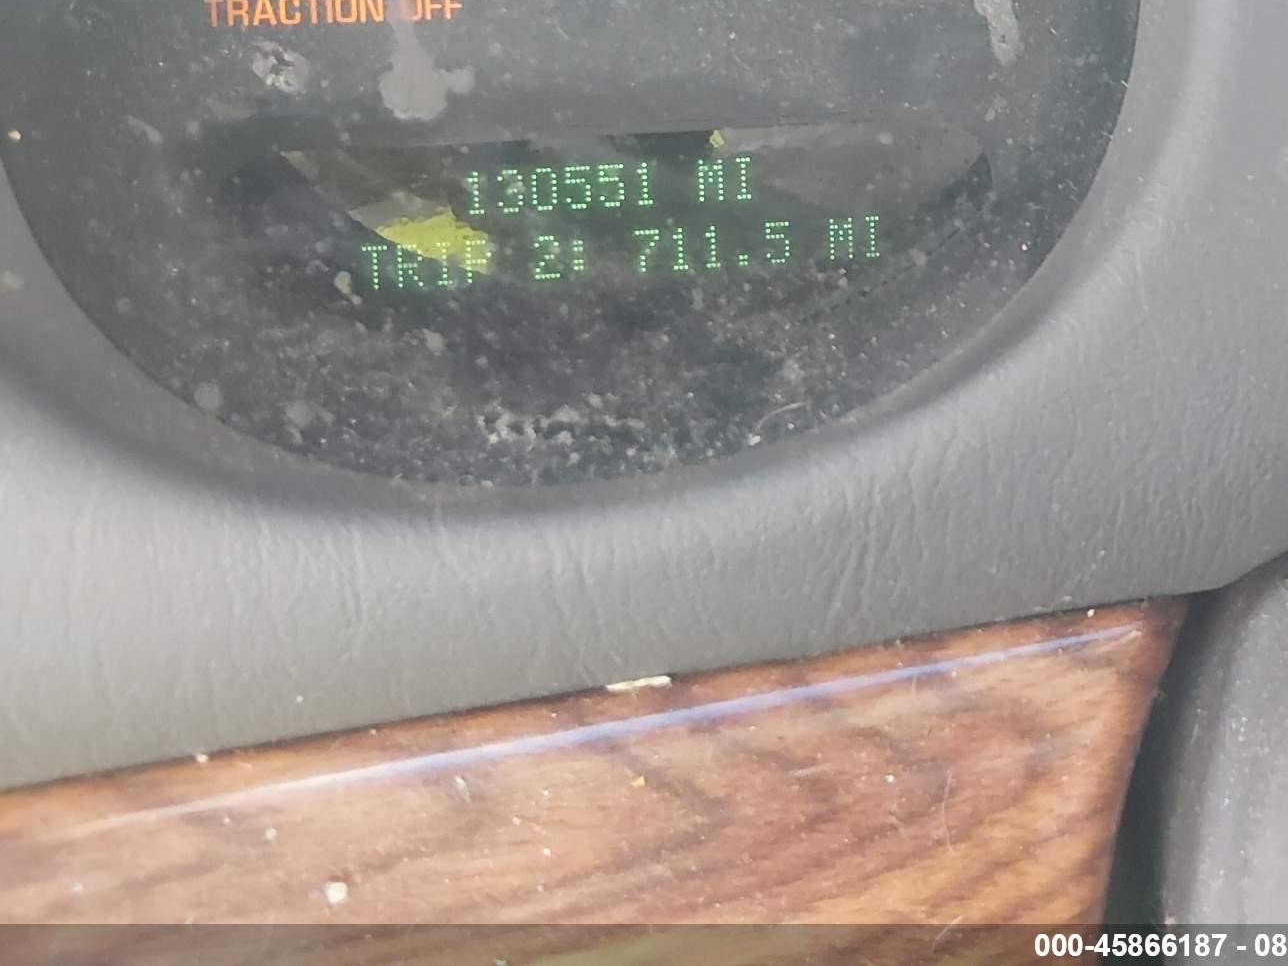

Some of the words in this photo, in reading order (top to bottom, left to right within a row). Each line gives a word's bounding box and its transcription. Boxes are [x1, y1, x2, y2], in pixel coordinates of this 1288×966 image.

[465, 162, 655, 216] 130551
[698, 156, 754, 203] MI
[361, 238, 492, 290] TRIP
[634, 221, 791, 274] 711.5
[827, 215, 882, 261] MI
